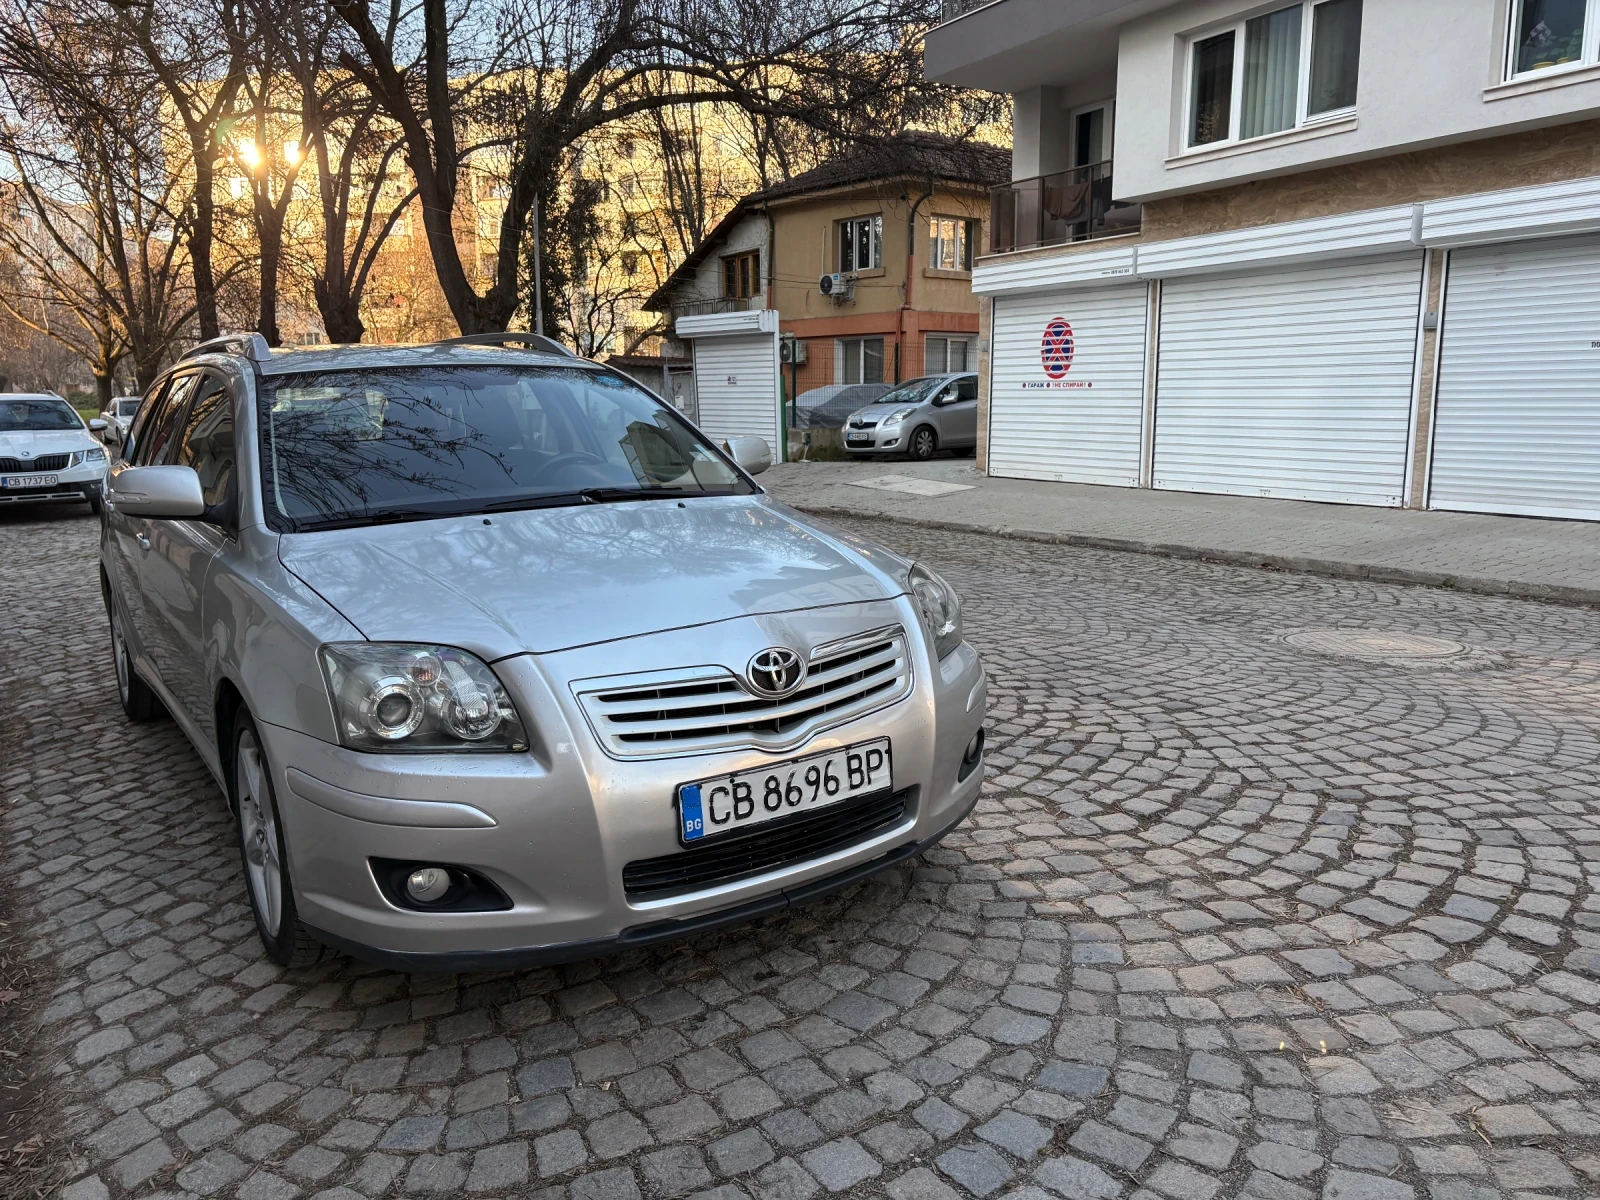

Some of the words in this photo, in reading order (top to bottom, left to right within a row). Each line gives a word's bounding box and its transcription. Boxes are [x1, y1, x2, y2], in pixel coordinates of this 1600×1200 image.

[8, 478, 21, 487] CB
[23, 476, 43, 486] 1737
[709, 780, 754, 825] CB
[763, 759, 840, 812] 8696
[847, 748, 883, 791] BP
[686, 818, 702, 833] BG
